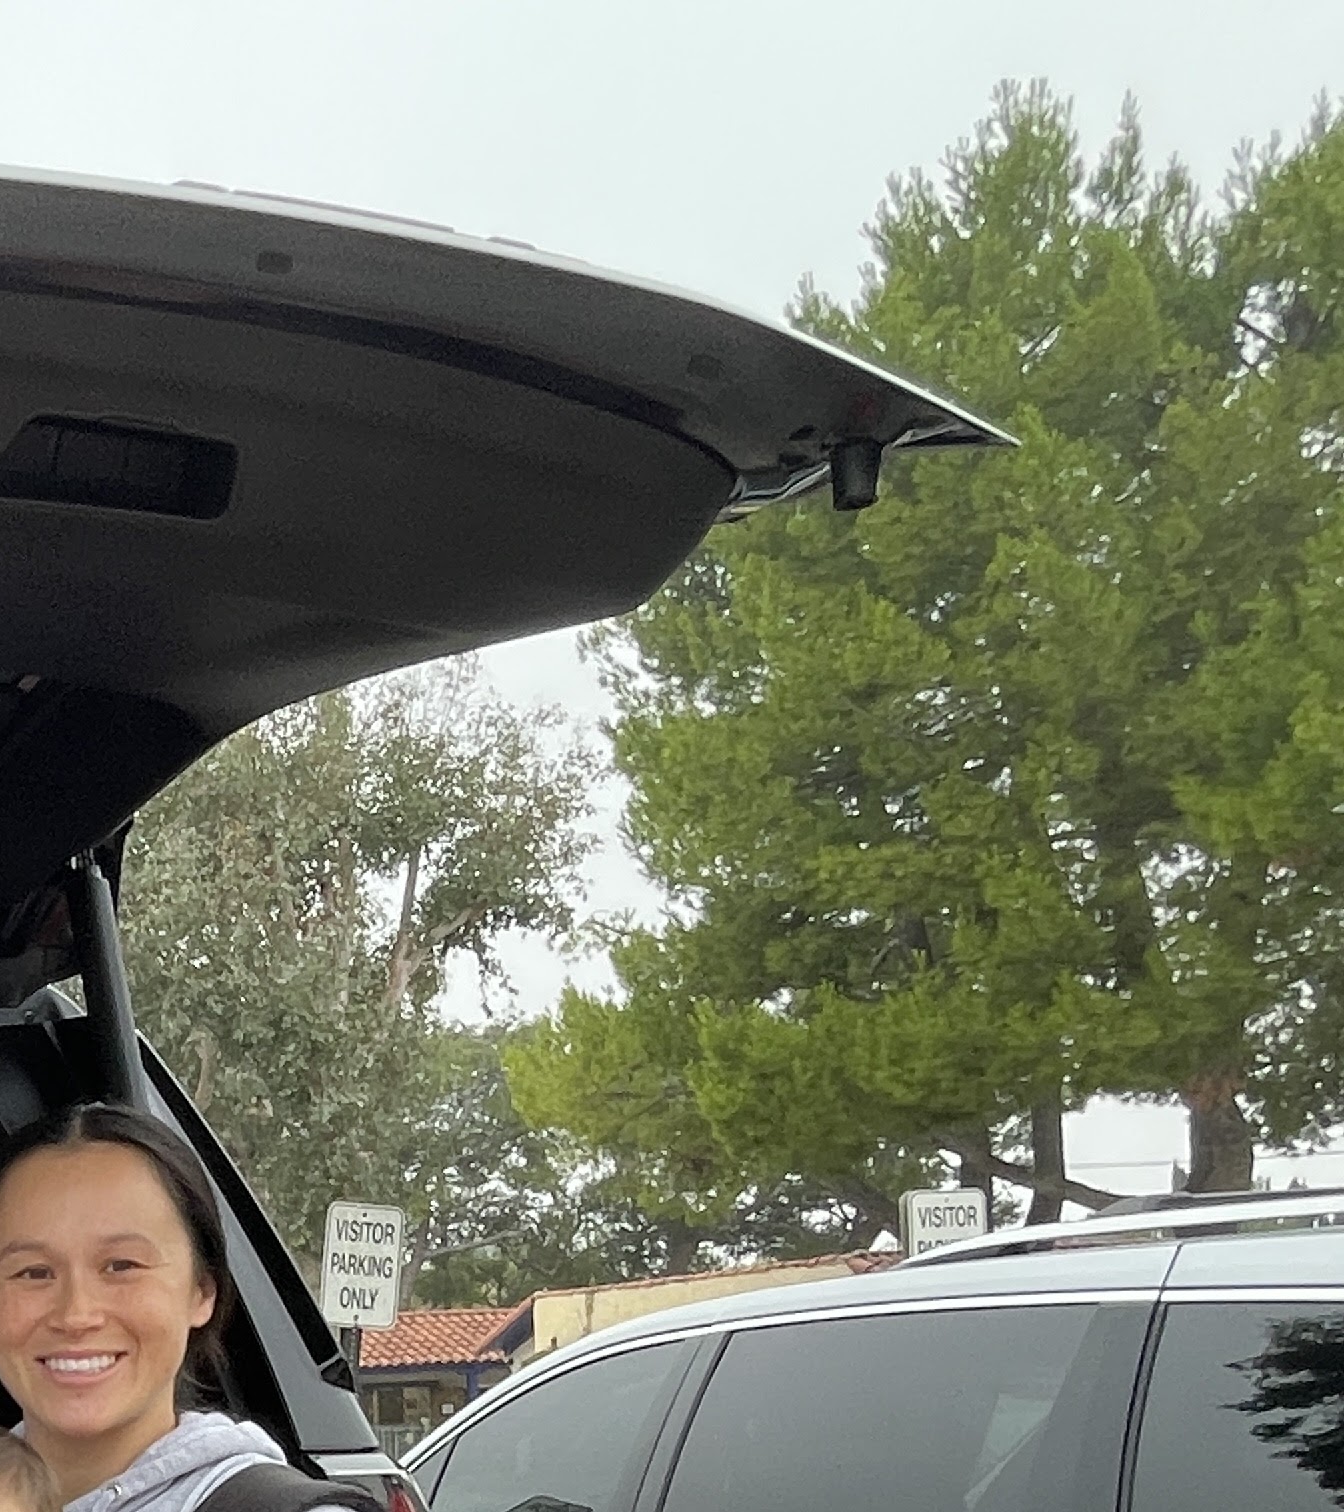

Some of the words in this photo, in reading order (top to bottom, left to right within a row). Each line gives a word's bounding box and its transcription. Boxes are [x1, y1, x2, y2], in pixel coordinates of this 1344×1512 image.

[917, 1205, 978, 1229] VISITOR
[336, 1218, 396, 1245] VISITOR
[330, 1252, 394, 1279] PARKING
[340, 1286, 379, 1310] ONLY
